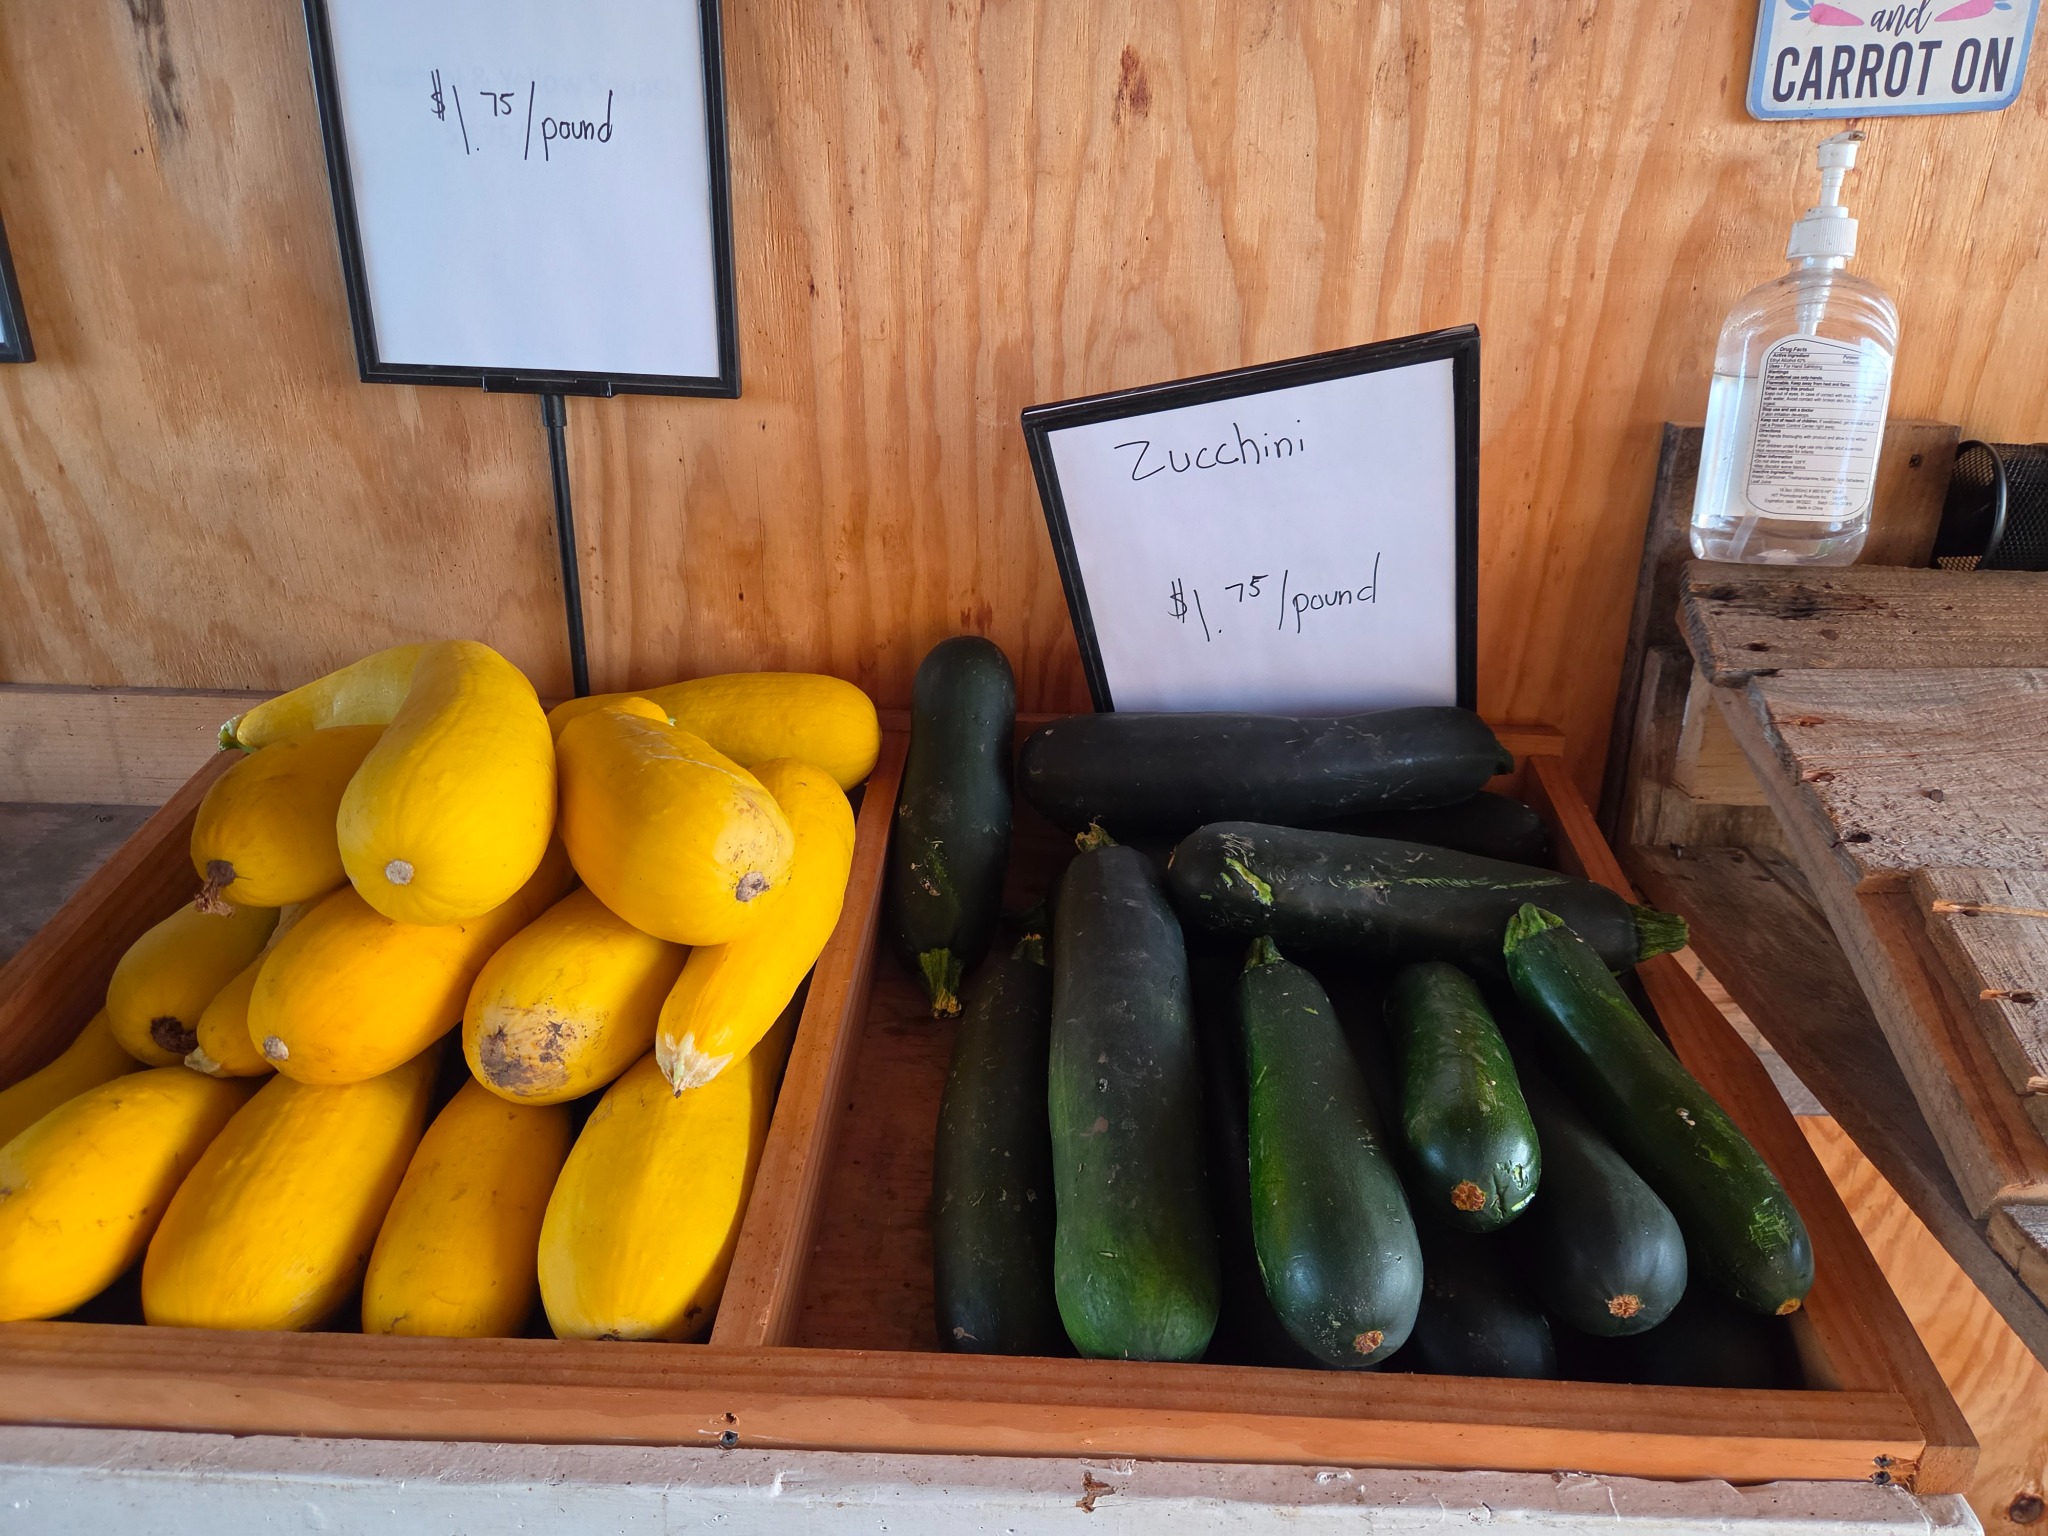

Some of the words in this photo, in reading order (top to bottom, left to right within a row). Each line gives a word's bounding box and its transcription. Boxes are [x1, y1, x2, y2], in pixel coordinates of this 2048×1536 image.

[1871, 0, 1934, 37] and
[1772, 40, 1942, 103] CARROT
[1951, 36, 2014, 95] ON
[1114, 418, 1305, 482] Zucchini
